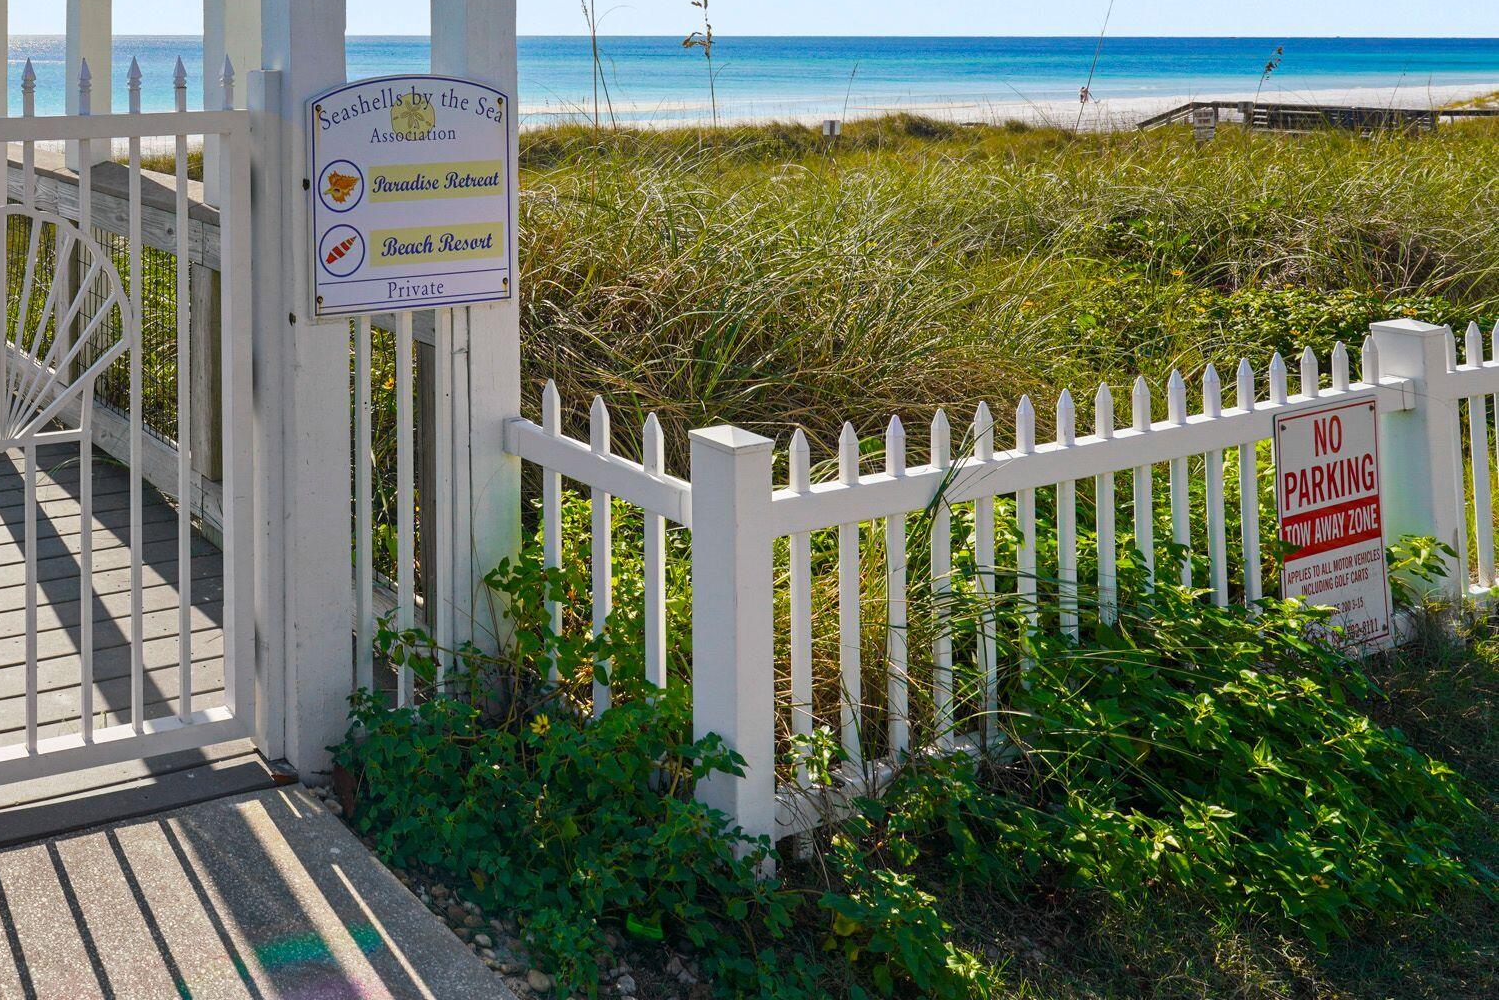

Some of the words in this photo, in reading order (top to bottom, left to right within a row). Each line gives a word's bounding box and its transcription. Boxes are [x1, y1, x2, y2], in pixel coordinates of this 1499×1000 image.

[318, 88, 404, 131] Seashells
[410, 85, 433, 110] by
[441, 88, 469, 111] the
[475, 96, 503, 124] Sea
[370, 125, 457, 144] Association
[372, 173, 439, 193] Paradise
[444, 171, 500, 189] Retreat
[381, 235, 433, 257] Beach
[438, 232, 493, 253] Resort
[387, 279, 444, 299] Private
[1313, 414, 1342, 457] NO
[1284, 453, 1375, 511] PARKING
[1285, 520, 1312, 547] TOW
[1314, 511, 1345, 545] AWAY
[1348, 503, 1378, 535] ZONE
[1287, 566, 1312, 585] APPLIES
[1312, 563, 1321, 578] TO
[1321, 561, 1332, 576] ALL
[1333, 555, 1353, 572] MOTOR
[1354, 548, 1381, 566] VEHICLES
[1301, 577, 1334, 596] INCLUDING
[1334, 572, 1349, 588] GOLF
[1350, 567, 1369, 584] CARTS
